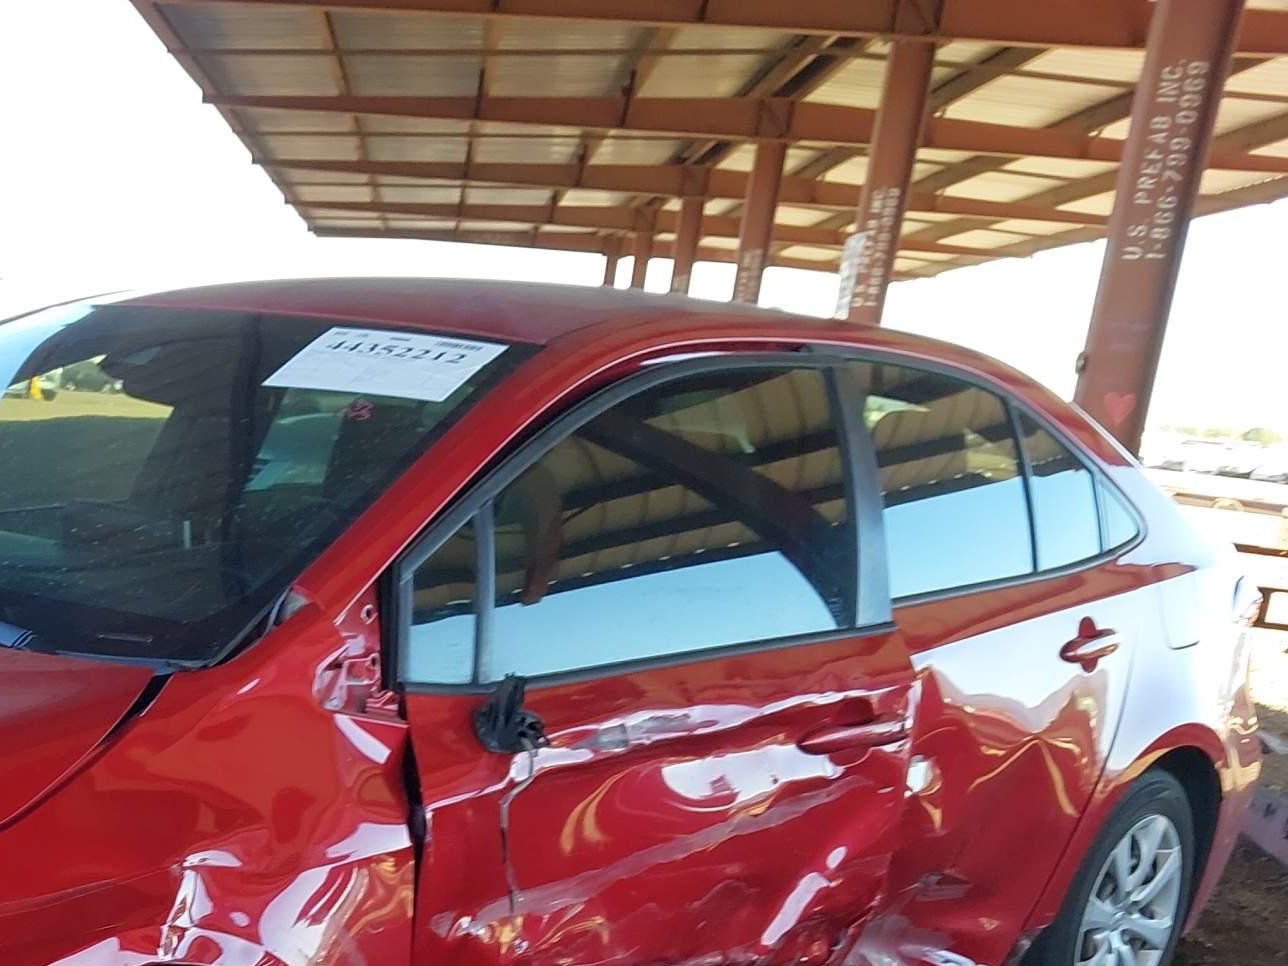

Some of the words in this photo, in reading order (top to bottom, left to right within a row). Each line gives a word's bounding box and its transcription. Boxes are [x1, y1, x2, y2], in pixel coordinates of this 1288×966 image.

[1133, 116, 1172, 204] PREFAB
[1144, 61, 1210, 259] 1-866-799-0969
[327, 340, 466, 363] 44352212
